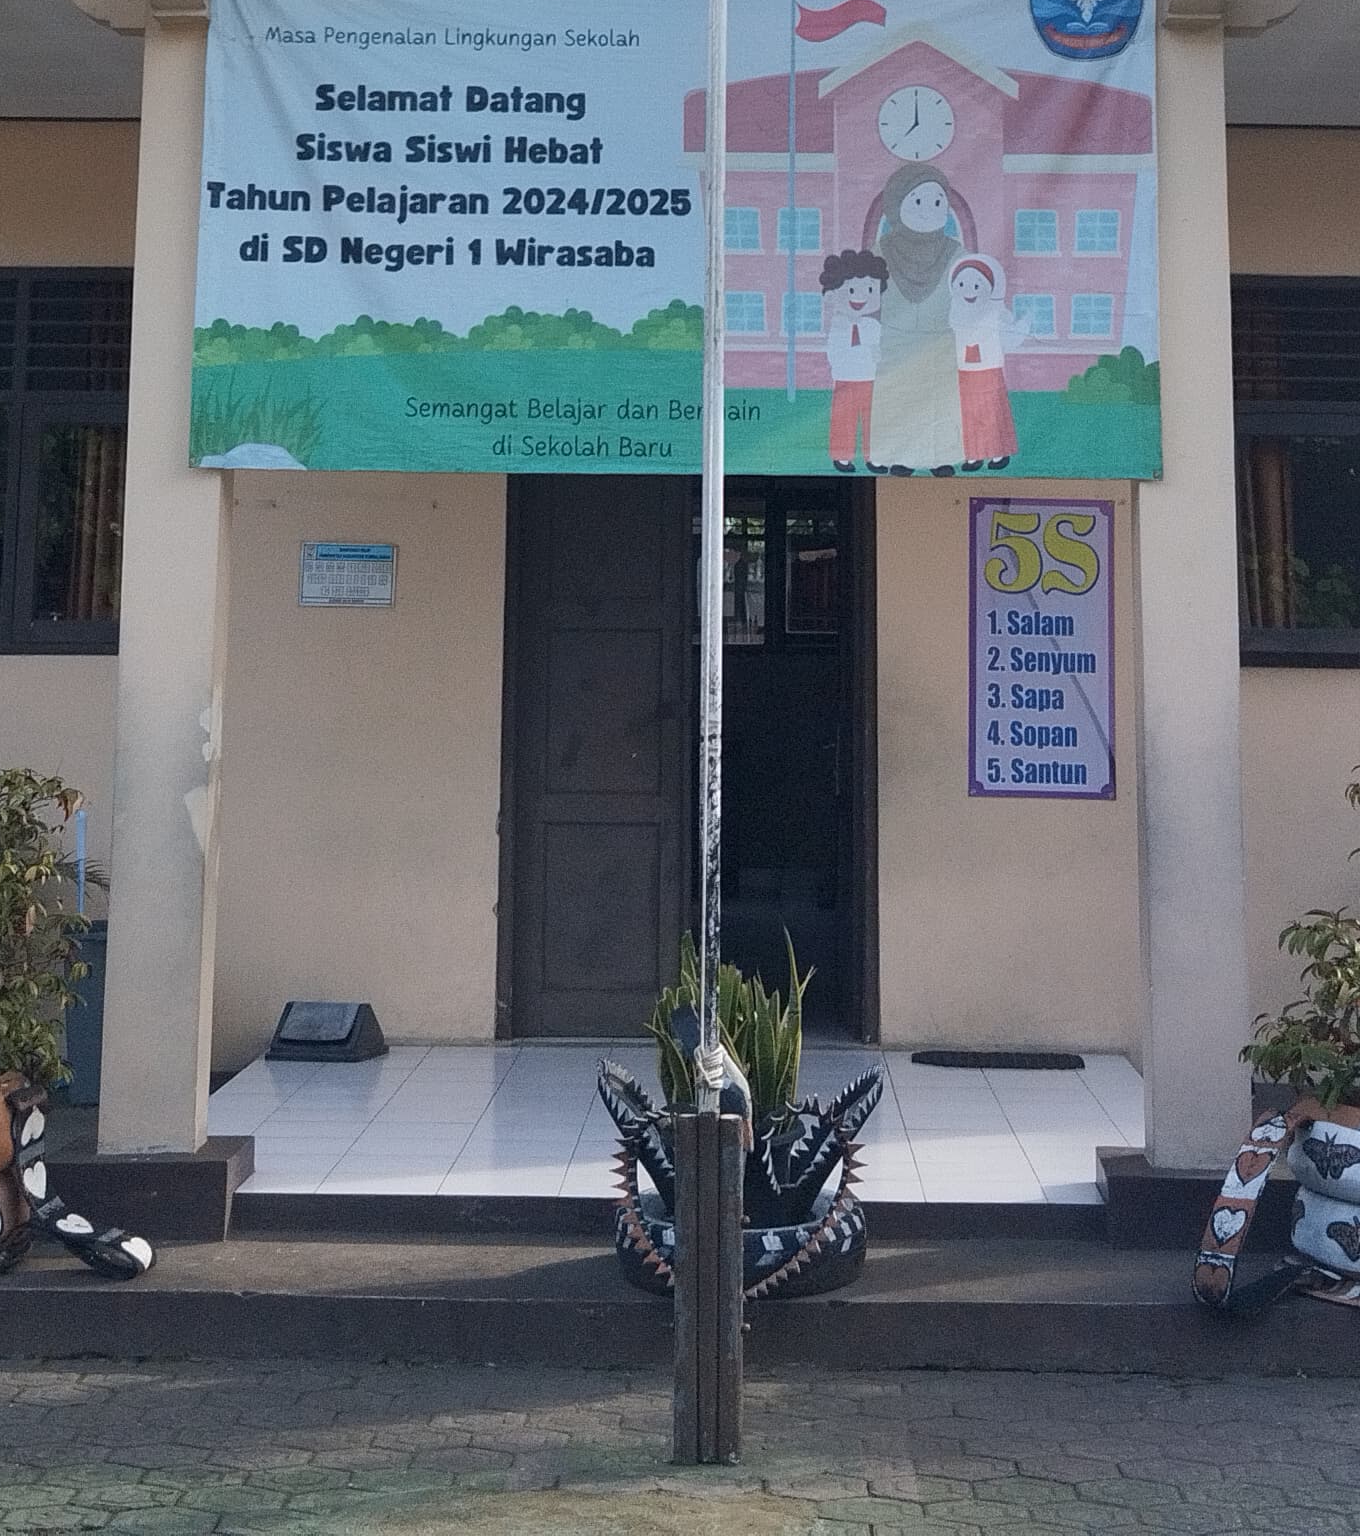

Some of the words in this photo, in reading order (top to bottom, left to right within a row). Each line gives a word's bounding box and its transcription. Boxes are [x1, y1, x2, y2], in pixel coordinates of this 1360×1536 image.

[265, 26, 317, 45] Masa
[324, 26, 437, 51] Pengenalan
[444, 27, 557, 52] Lingkungan
[564, 28, 640, 48] Sekolah
[315, 83, 453, 113] Selamat
[465, 85, 587, 121] Datang
[295, 132, 393, 164] Siswa
[405, 133, 492, 164] Siswi
[504, 136, 604, 166] Hebat
[206, 181, 311, 213] Tahun
[322, 183, 490, 225] Pelajaran
[502, 186, 692, 217] 2024/2025
[239, 232, 269, 263] di
[282, 235, 328, 264] SD
[340, 236, 455, 273] Negeri
[468, 238, 483, 266] 1
[495, 236, 656, 268] Wirasaba
[405, 396, 519, 426] Semangat
[527, 396, 608, 427] Belajar
[616, 397, 659, 421] dan
[669, 399, 761, 421] Berain
[491, 433, 512, 457] di
[520, 433, 610, 458] Sekolah
[618, 435, 673, 459] Baru
[984, 510, 1100, 596] 5S
[987, 610, 1003, 635] 1.
[1007, 610, 1075, 637] Salam
[987, 646, 1006, 672] 2.
[1010, 646, 1097, 676] Senyum
[987, 682, 1006, 709] 3.
[1011, 683, 1065, 713] Sapa
[987, 719, 1005, 746] 4.
[1010, 720, 1078, 750] Sopan
[987, 757, 1006, 784] 5.
[1011, 757, 1087, 786] Santun
